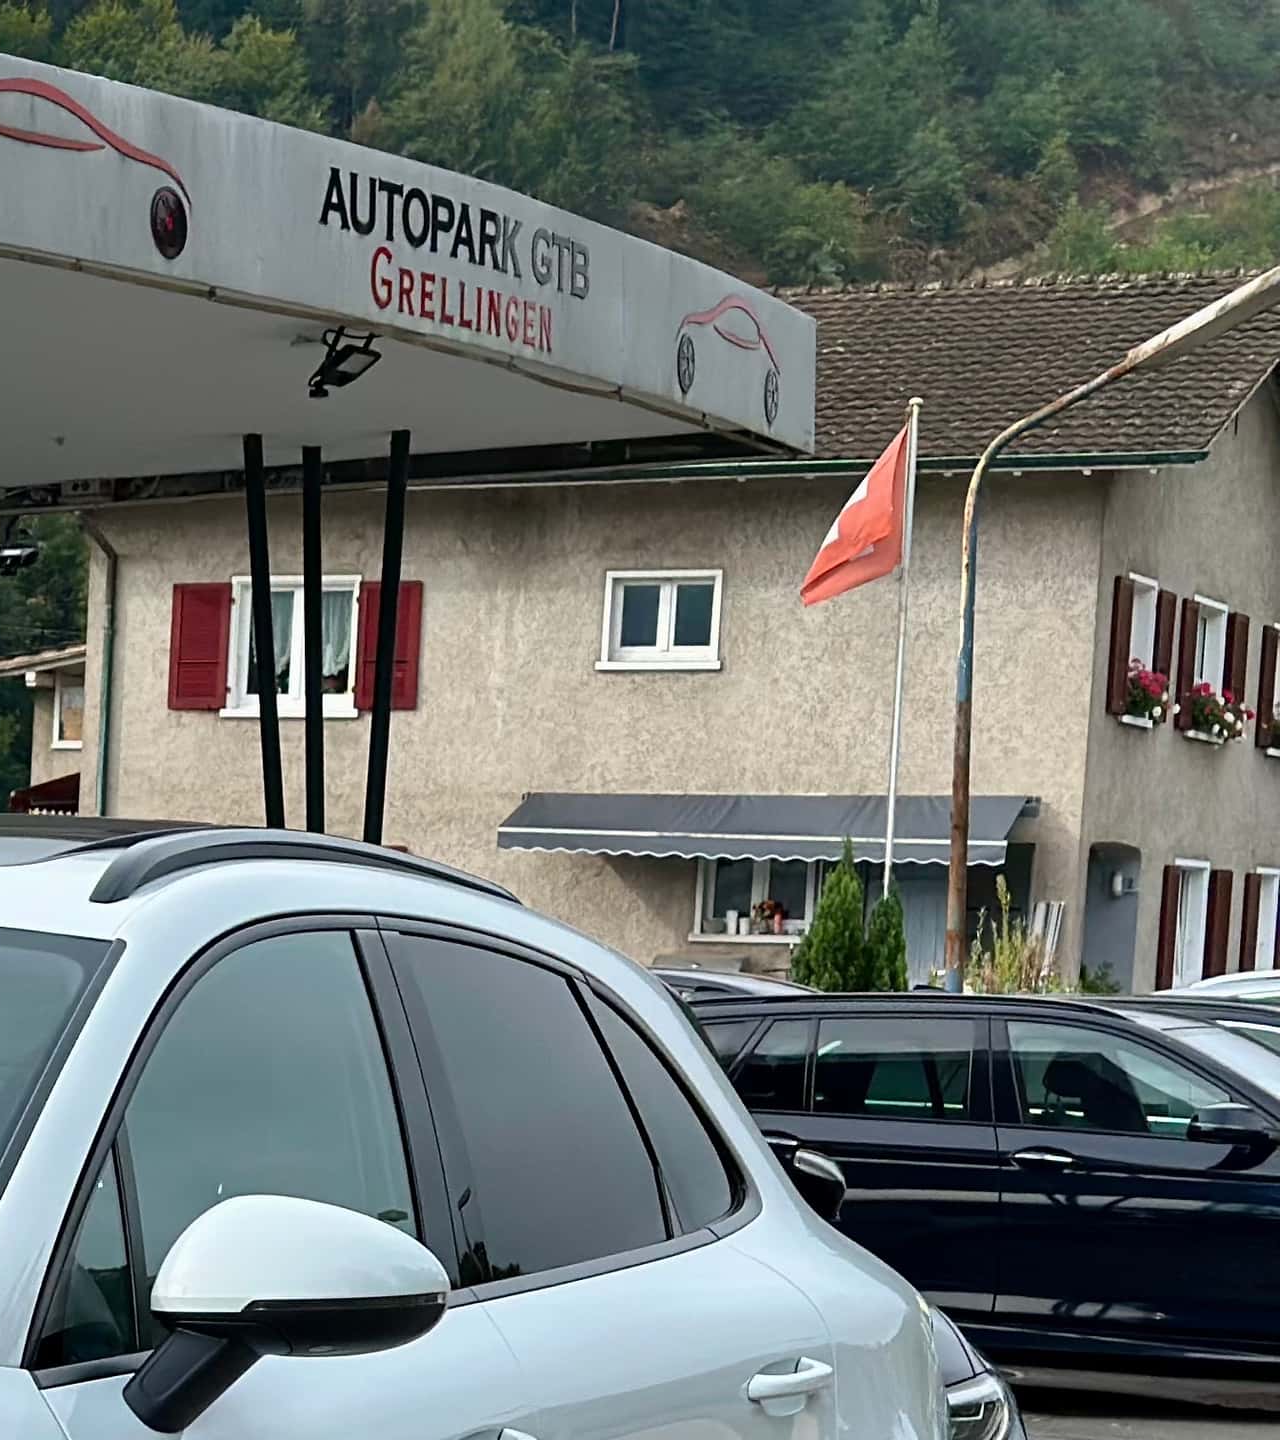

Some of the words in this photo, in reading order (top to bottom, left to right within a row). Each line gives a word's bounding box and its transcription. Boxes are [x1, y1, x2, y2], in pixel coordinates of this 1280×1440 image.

[318, 166, 523, 280] AUTOPARK
[530, 227, 591, 301] GTB
[370, 246, 553, 353] GRELLINGEN
